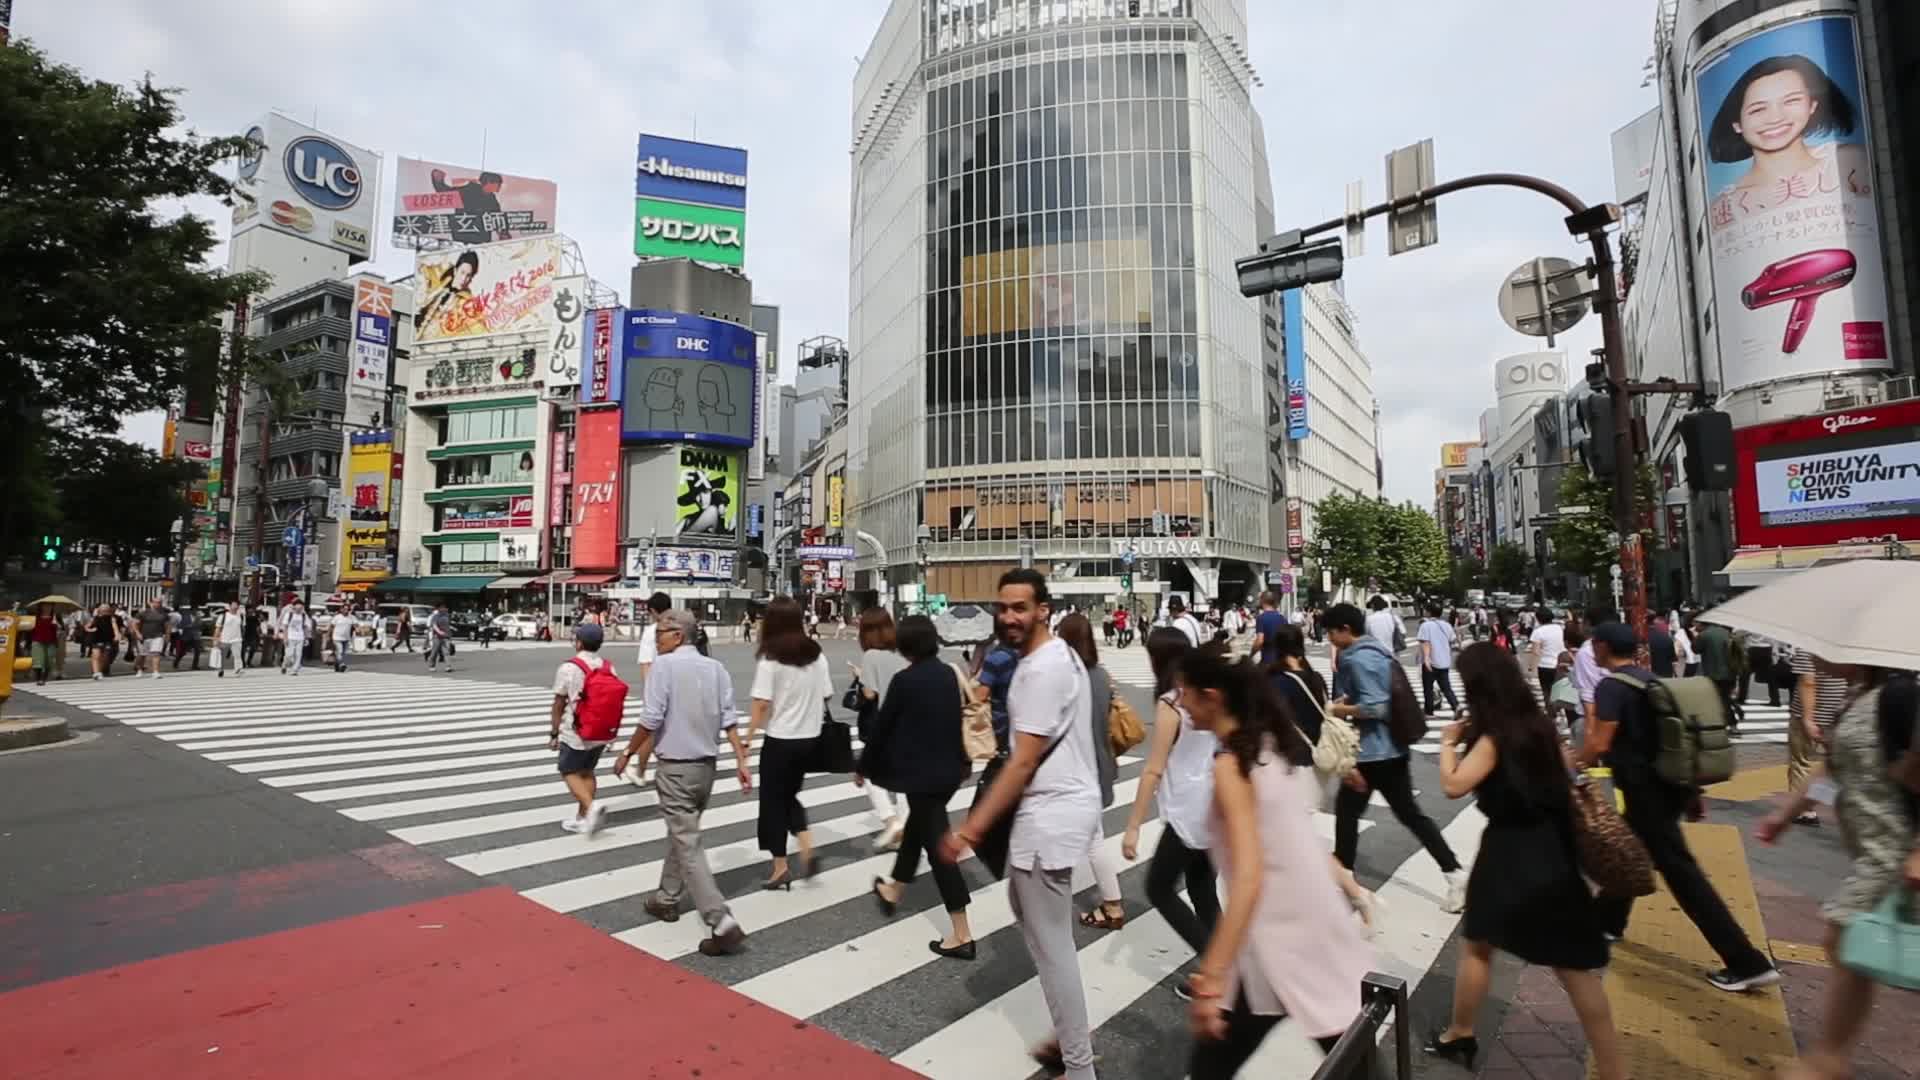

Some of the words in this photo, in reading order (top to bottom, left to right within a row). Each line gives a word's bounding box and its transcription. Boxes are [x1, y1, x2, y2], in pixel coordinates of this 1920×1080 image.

[638, 156, 746, 187] Hisamitsu
[413, 194, 454, 208] LOSER
[336, 226, 367, 245] VISA
[399, 211, 507, 236] 米津玄師
[640, 215, 741, 247] サロンパス
[529, 259, 555, 283] 2016
[358, 285, 392, 315] 本
[550, 287, 582, 381] もんじゃ
[676, 336, 710, 352] DHC
[1288, 378, 1305, 428] SEIBU
[1822, 415, 1877, 433] Glico
[680, 449, 729, 472] DMM
[1786, 453, 1882, 477] SHIBUYA
[680, 470, 712, 489] FX
[1787, 463, 1920, 490] COMMUNITY
[1788, 485, 1851, 504] NEWS
[1114, 538, 1202, 556] TSUTAYA
